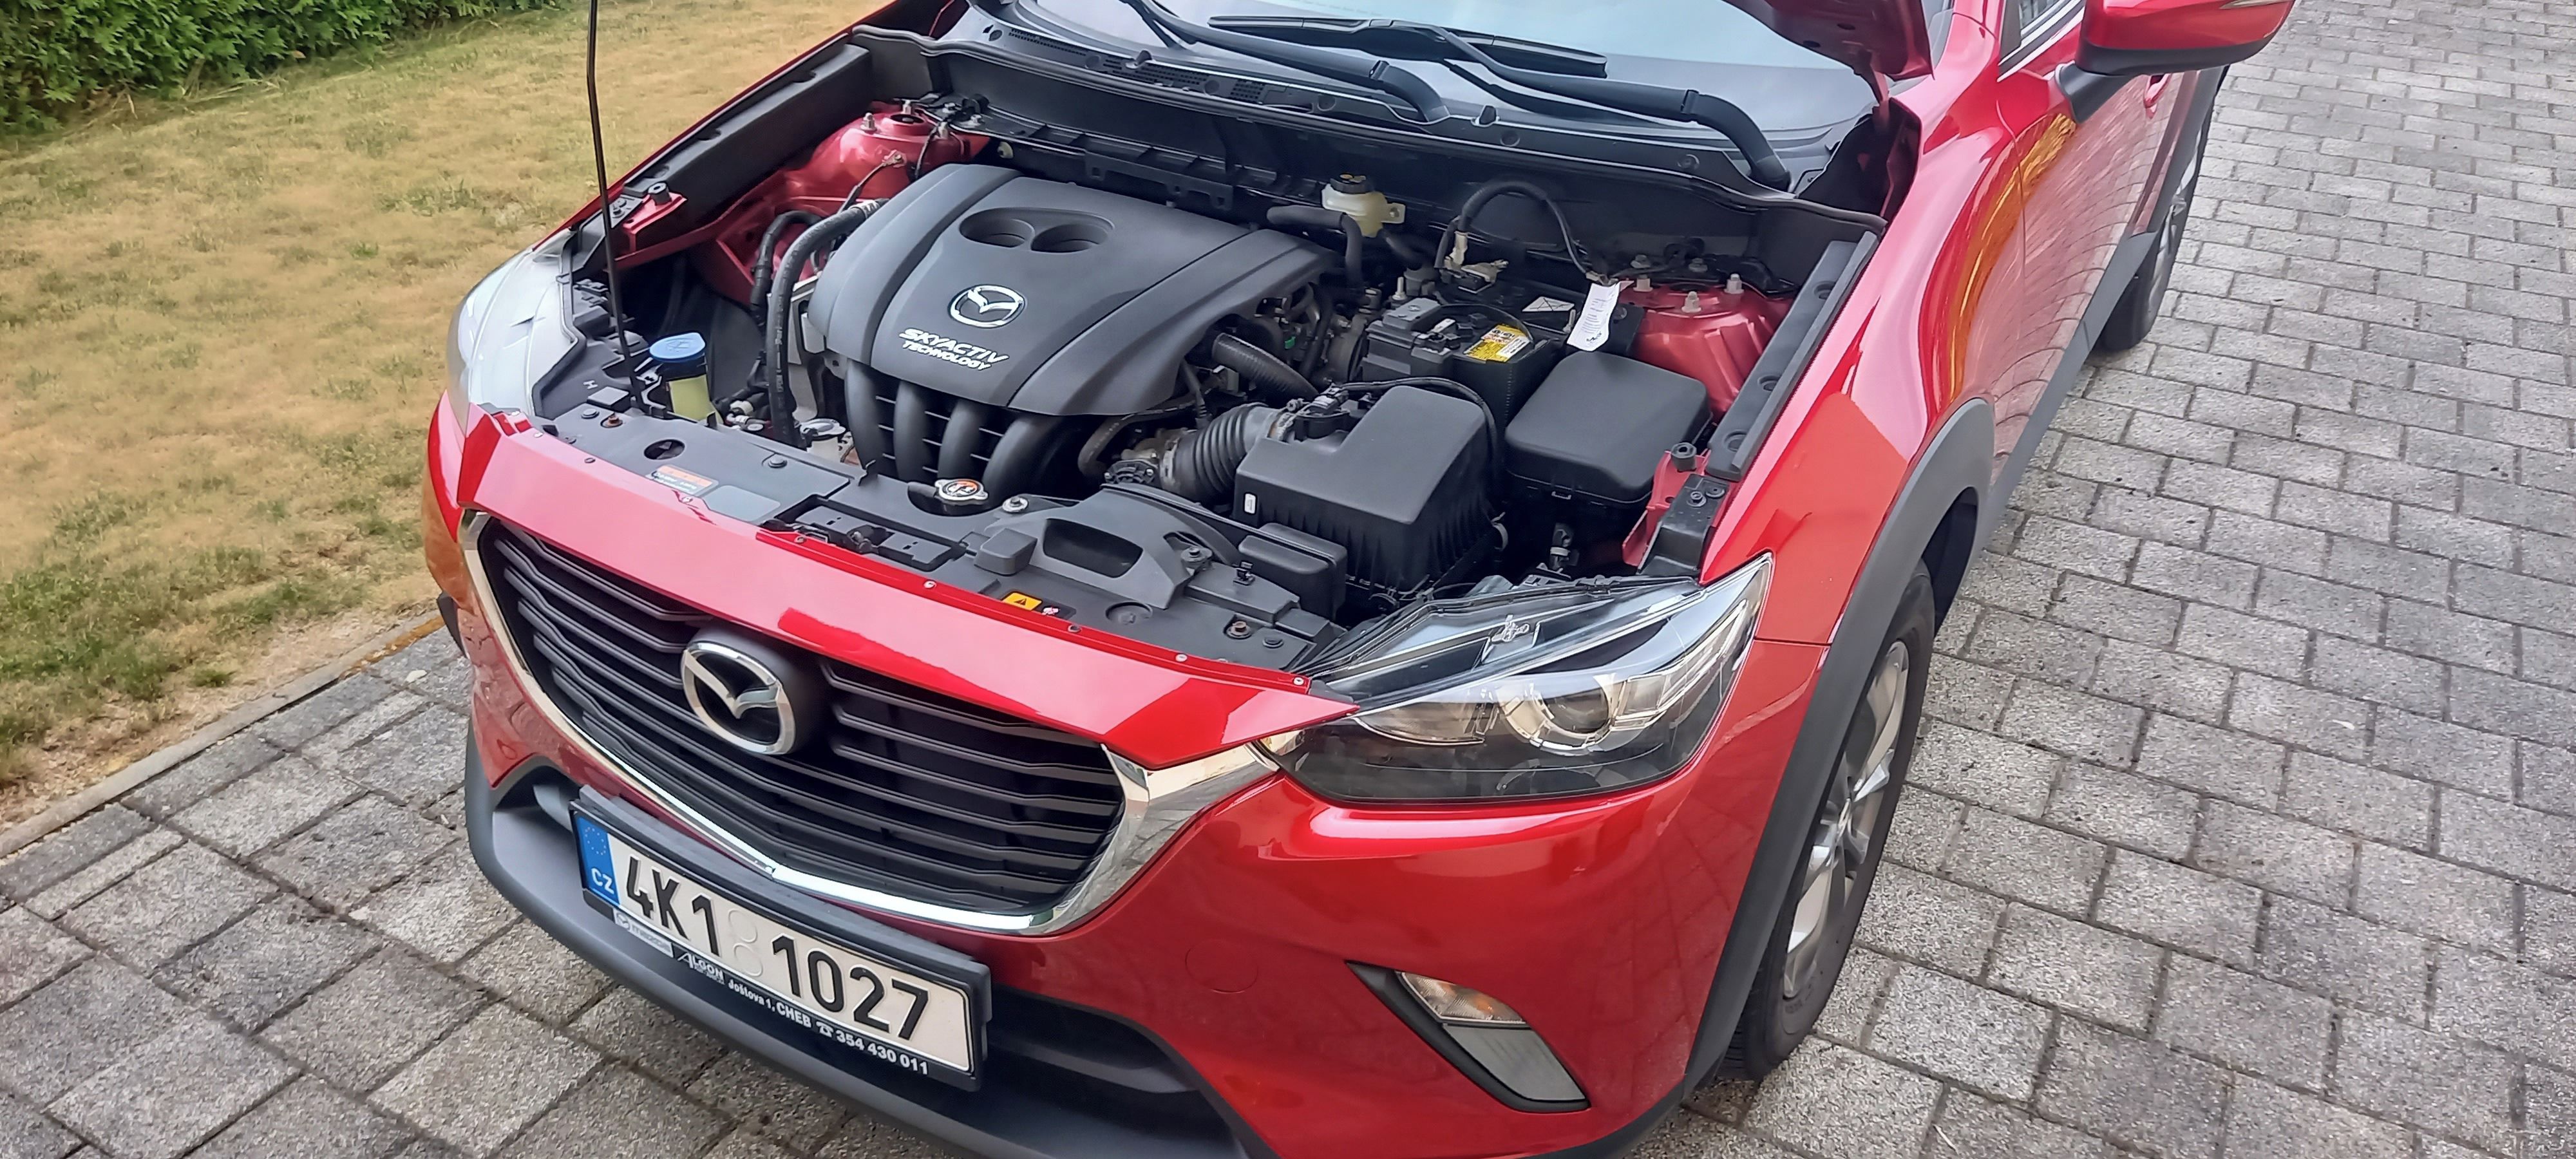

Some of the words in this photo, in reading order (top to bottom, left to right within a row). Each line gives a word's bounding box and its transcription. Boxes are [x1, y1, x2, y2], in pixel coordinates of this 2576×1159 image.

[899, 328, 1009, 363] SKYACTIV
[902, 340, 991, 370] TECHNOLOGY
[591, 867, 614, 894] CZ
[626, 856, 720, 957] 4K1
[772, 935, 929, 1041] 1027
[776, 1001, 812, 1028] CHEB
[836, 1030, 865, 1051] 354
[867, 1042, 897, 1063] 430
[899, 1053, 928, 1075] 011
